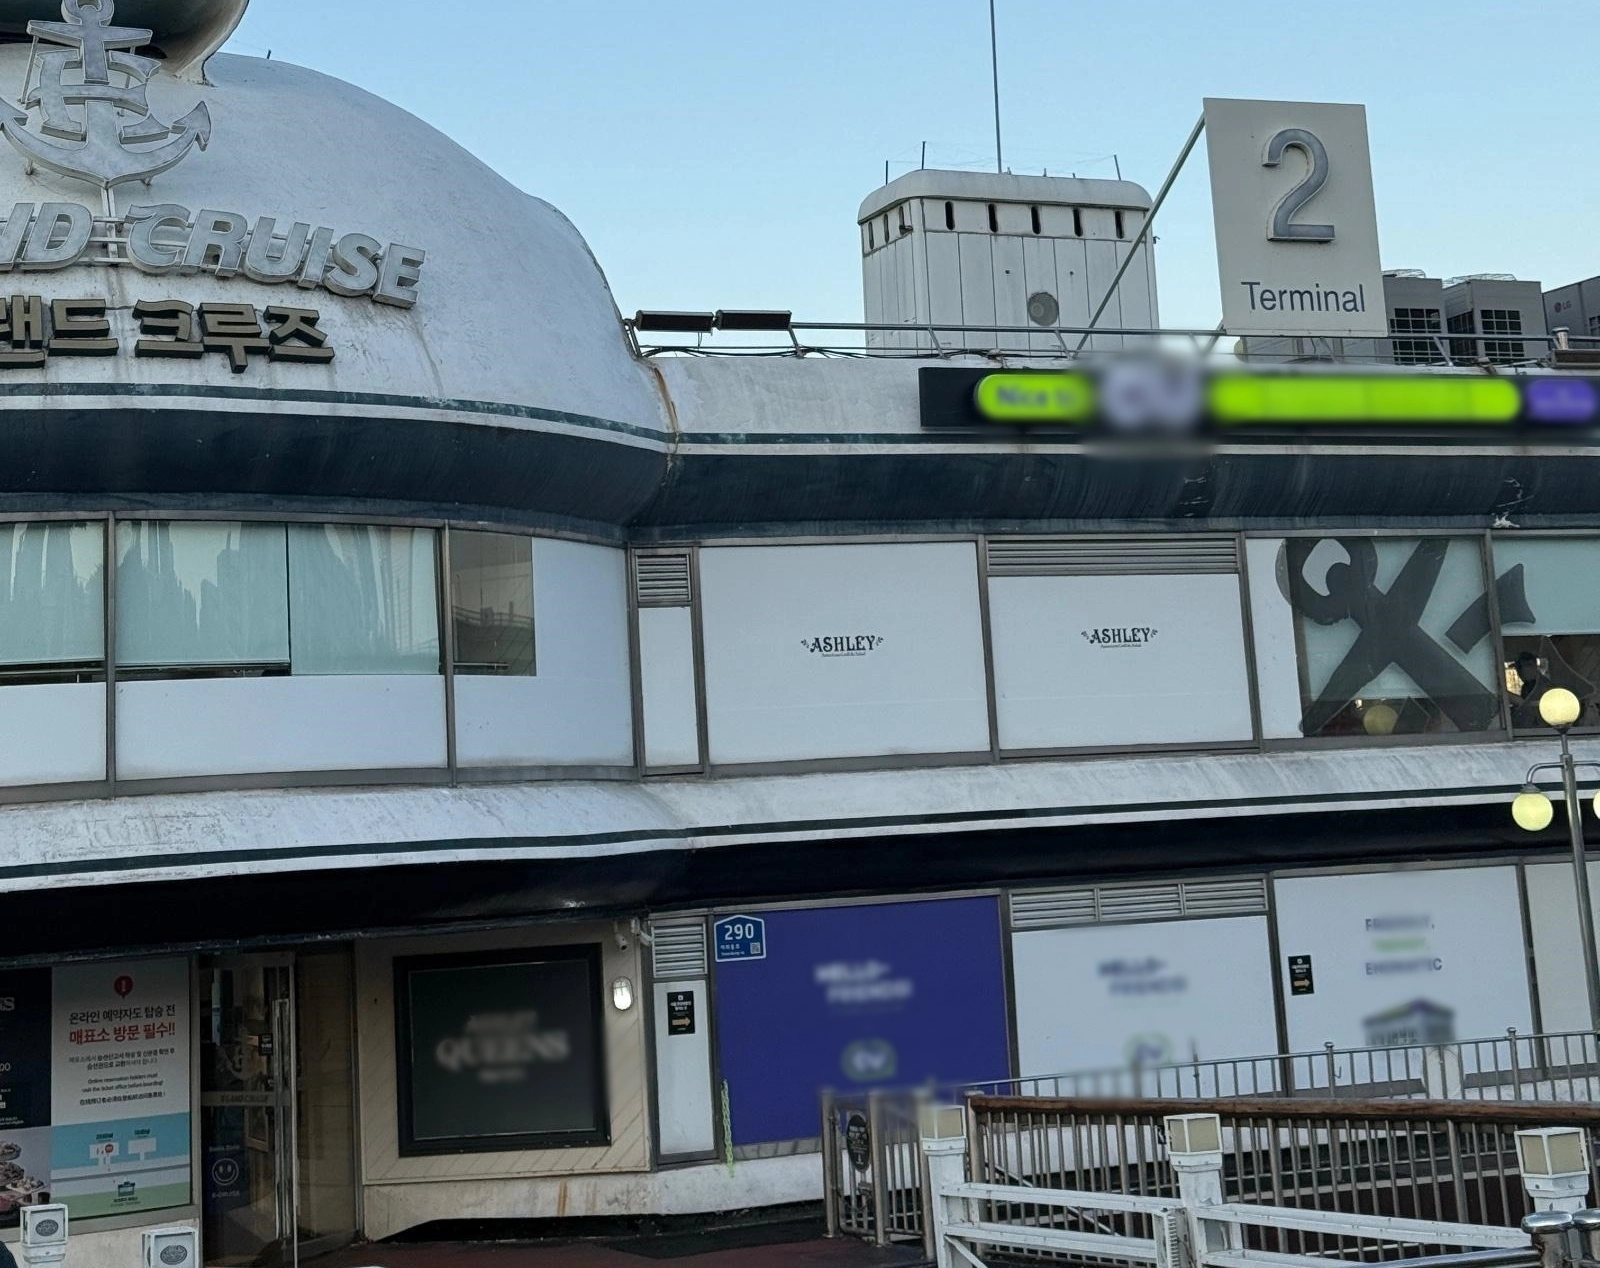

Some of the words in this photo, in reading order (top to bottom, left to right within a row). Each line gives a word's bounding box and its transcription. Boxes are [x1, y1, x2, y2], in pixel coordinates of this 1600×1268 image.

[1262, 128, 1335, 243] 2
[126, 203, 426, 309] CRUISE
[1241, 281, 1365, 313] Terminal
[809, 635, 876, 653] ASHLEY
[1089, 627, 1151, 645] ASHLEY
[724, 923, 754, 941] 290
[69, 1010, 100, 1025] 온라인
[102, 1007, 143, 1022] 예약자도
[145, 1005, 164, 1019] 탑승
[166, 1003, 176, 1017] 전
[69, 1027, 110, 1045] 매표소
[113, 1024, 140, 1042] 방문
[143, 1021, 176, 1039] 필수!!
